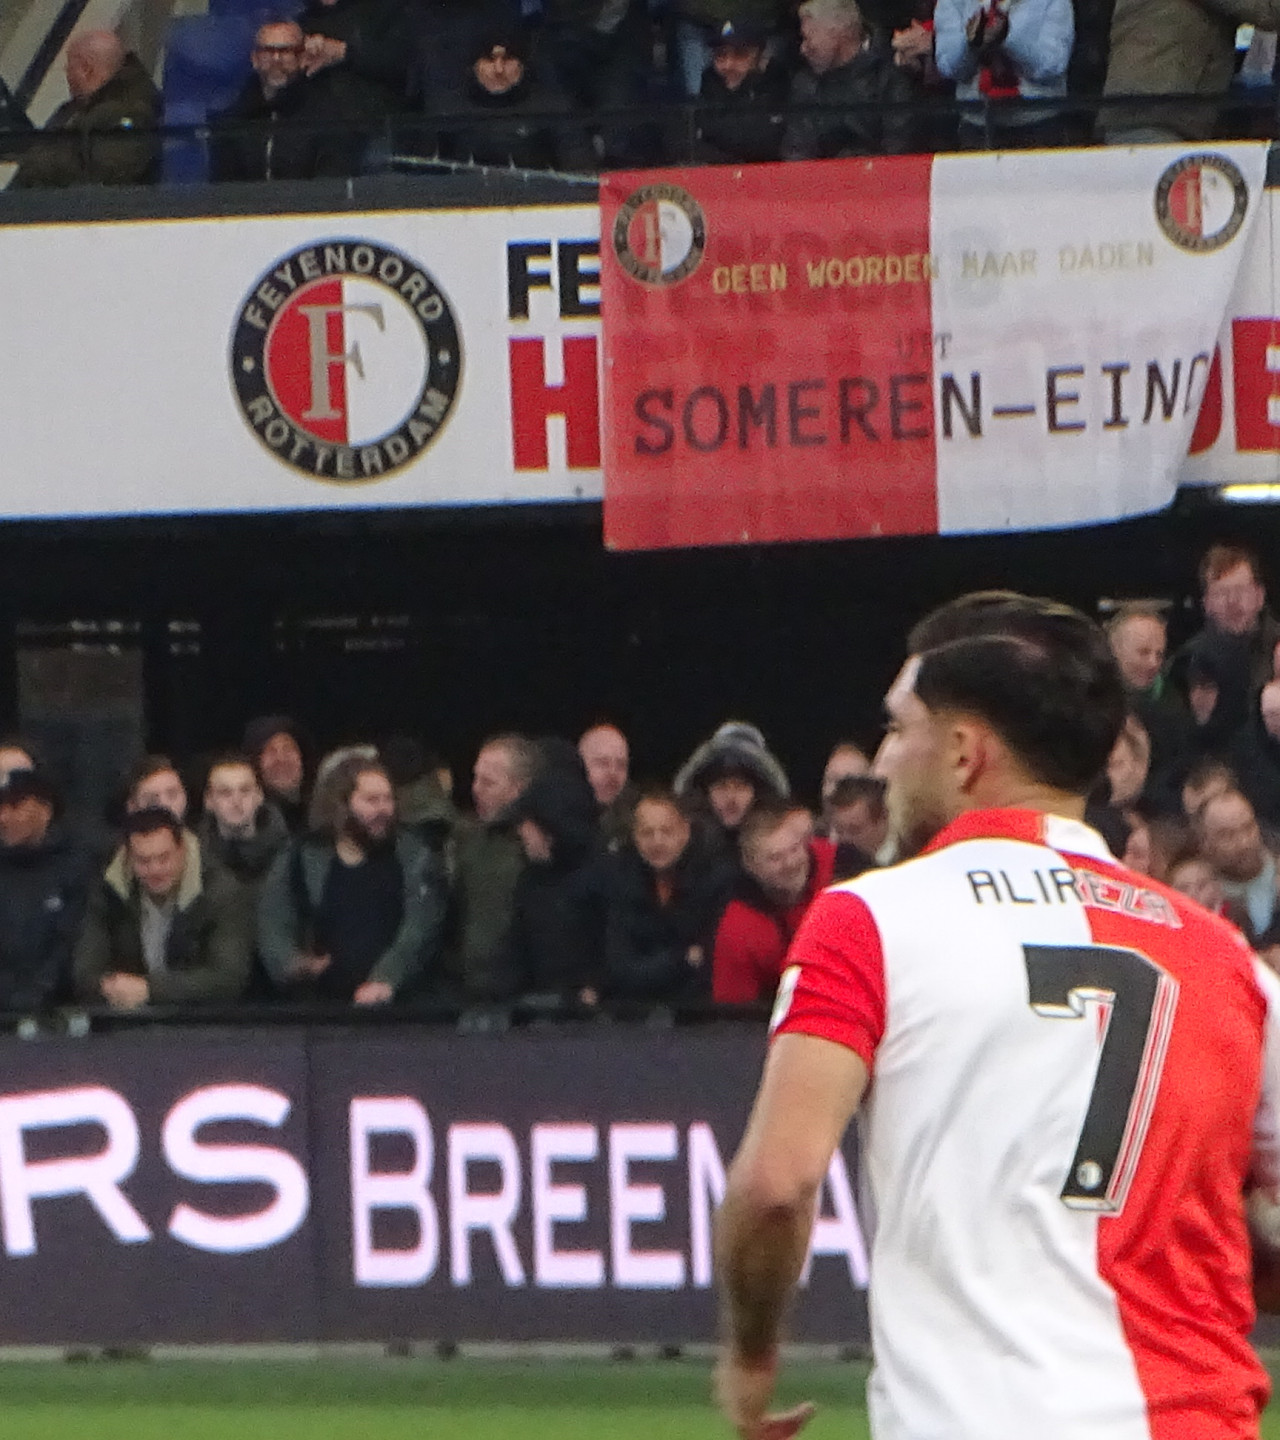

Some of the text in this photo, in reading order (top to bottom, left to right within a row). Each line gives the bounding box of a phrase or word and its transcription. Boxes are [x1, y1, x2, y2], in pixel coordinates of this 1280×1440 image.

[244, 245, 444, 328] FEYENOORD
[712, 262, 788, 295] GEEN
[806, 253, 940, 288] WOORDEN
[1058, 241, 1155, 273] DADEN
[247, 388, 449, 479] ROTTERDAM
[1020, 942, 1181, 1218] 7
